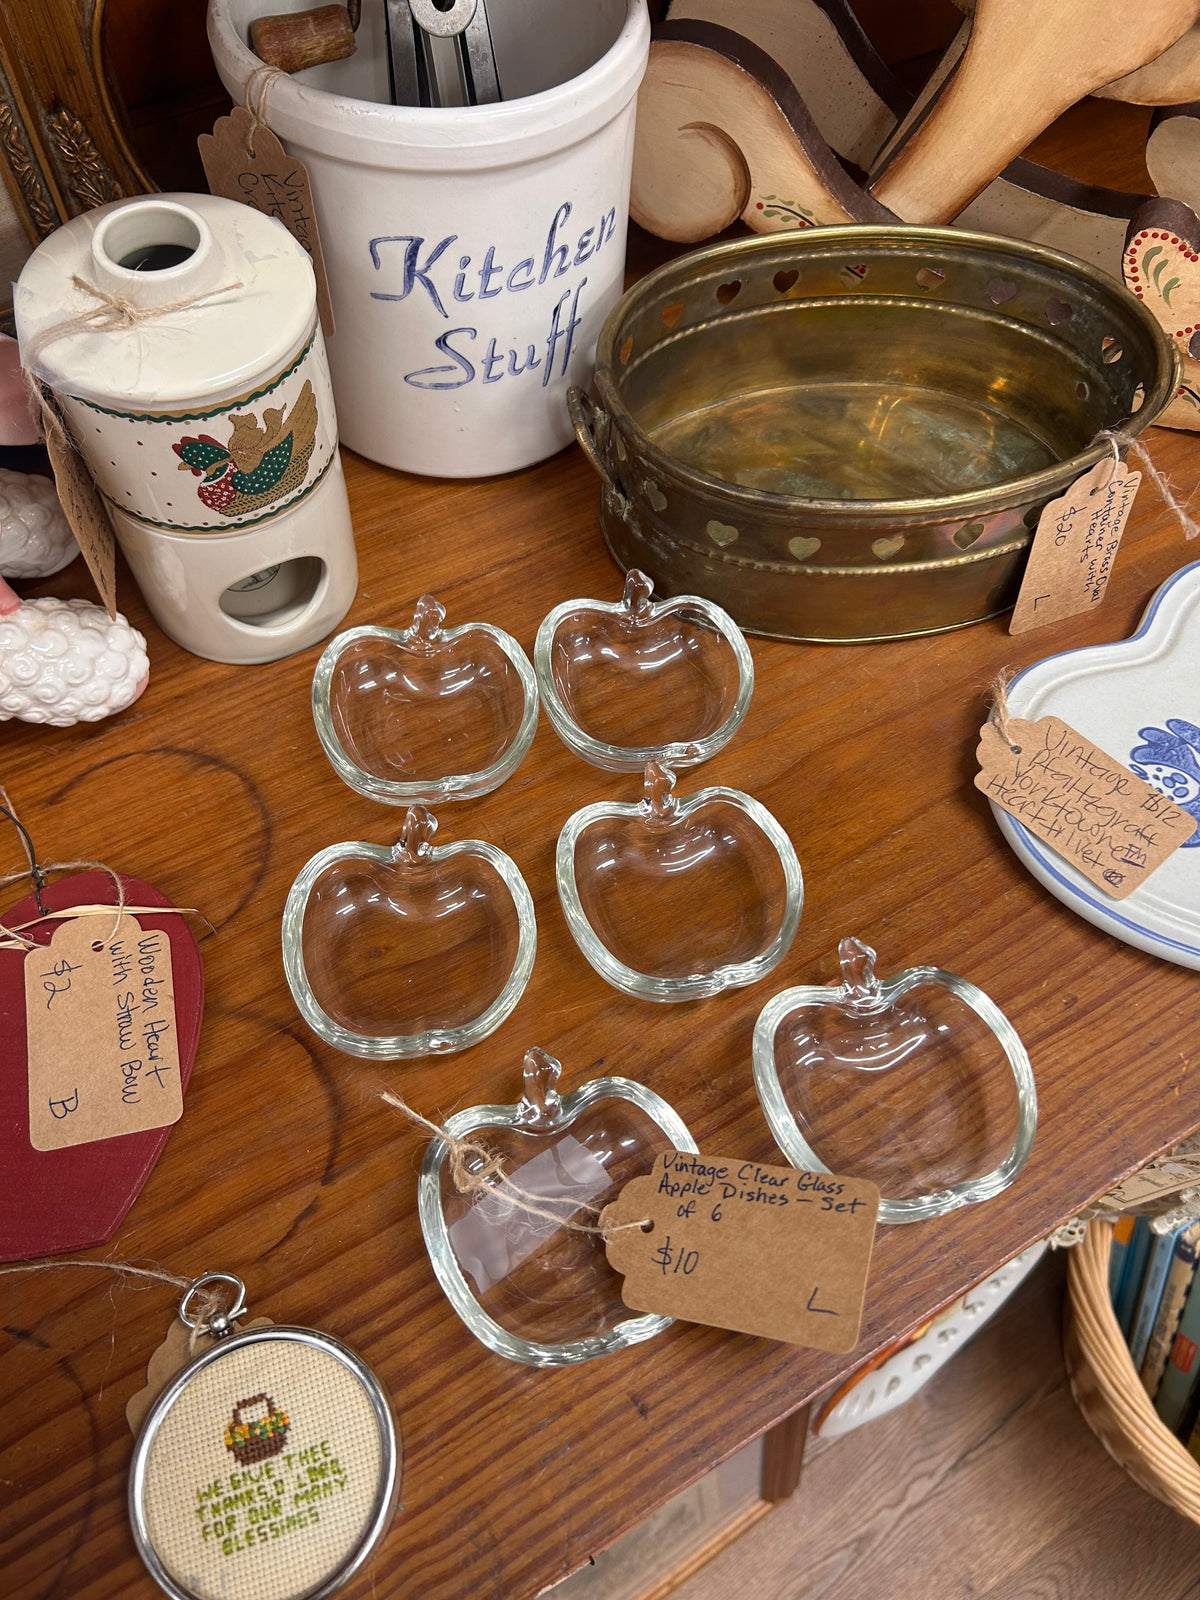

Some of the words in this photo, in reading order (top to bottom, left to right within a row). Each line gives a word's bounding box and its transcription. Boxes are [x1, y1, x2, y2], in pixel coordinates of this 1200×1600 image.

[368, 201, 616, 318] Kitchen
[404, 277, 588, 390] Stuff
[1054, 506, 1087, 547] $20
[1095, 480, 1124, 552] Container
[1110, 477, 1138, 537] Vintage
[1080, 509, 1103, 563] Hearts
[1099, 540, 1118, 574] Brass
[1083, 558, 1098, 593] with
[1090, 576, 1108, 603] Oval
[1033, 594, 1051, 611] L
[986, 773, 1046, 822] Heart
[1044, 724, 1132, 797] Vintage
[1140, 792, 1182, 828] $12
[1011, 759, 1127, 863] Yorktowne
[39, 958, 84, 1010] $2
[137, 934, 165, 1014] Wooden
[116, 991, 141, 1051] Straw
[142, 1019, 172, 1089] Heart
[48, 1087, 80, 1120] B
[120, 1059, 143, 1104] Bow
[658, 1177, 711, 1197] Apple
[719, 1182, 789, 1206] Dishes
[820, 1195, 867, 1214] Set
[663, 1152, 729, 1187] Vintage
[737, 1163, 789, 1188] Clear
[797, 1172, 845, 1195] Glass
[677, 1200, 697, 1218] of
[711, 1203, 723, 1222] 6
[651, 1235, 700, 1275] $10
[806, 1287, 840, 1317] L
[196, 1479, 224, 1502] WE
[229, 1461, 275, 1491] GIVE
[282, 1440, 331, 1470] THEE
[202, 1514, 237, 1542] FOR
[247, 1499, 282, 1525] OUR
[294, 1474, 348, 1508] MANY
[221, 1505, 320, 1556] BLESSINGS
